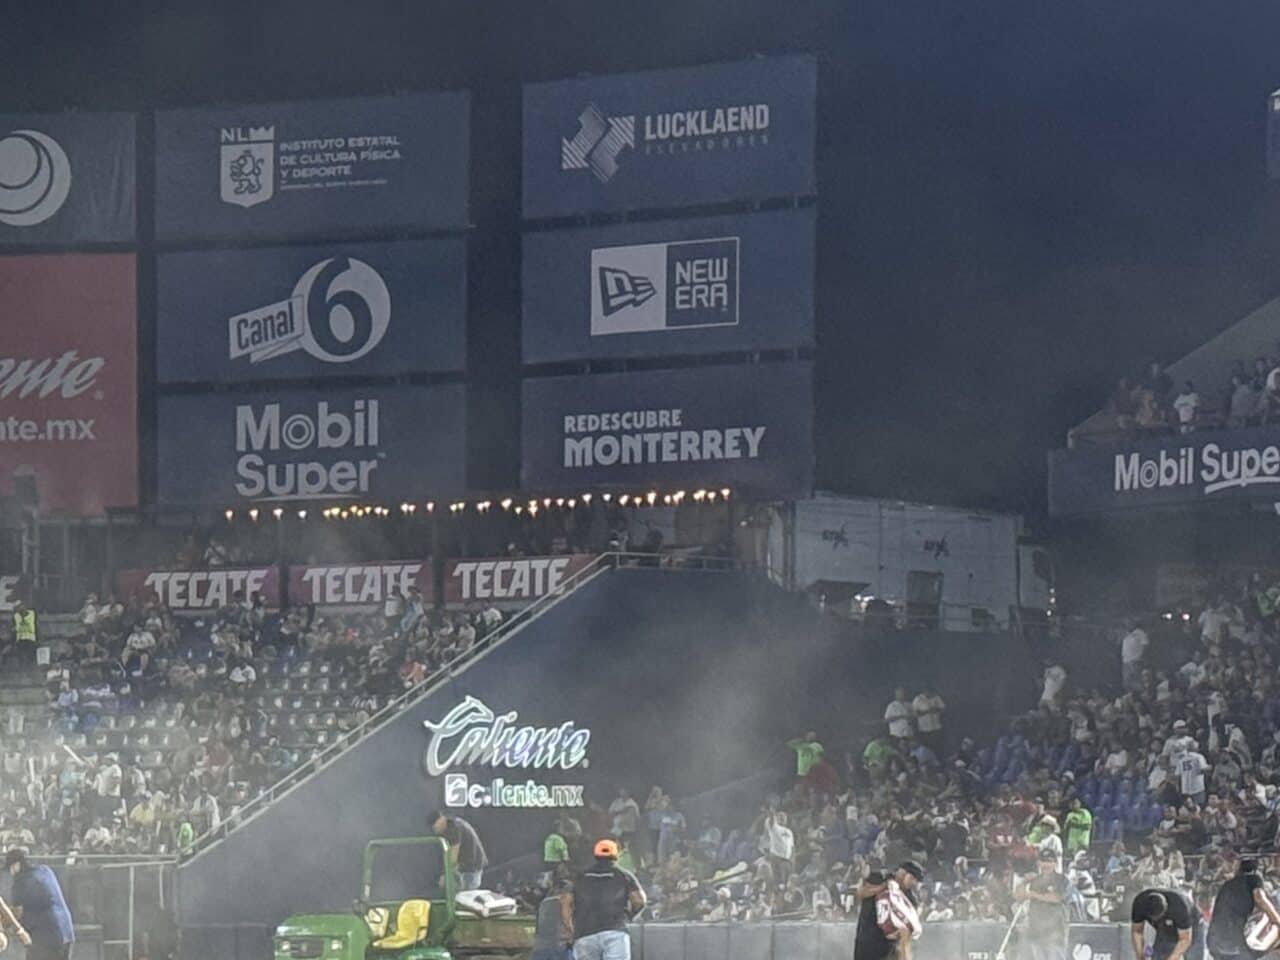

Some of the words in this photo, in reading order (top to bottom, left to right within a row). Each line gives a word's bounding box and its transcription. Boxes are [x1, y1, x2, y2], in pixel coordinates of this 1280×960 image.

[645, 104, 769, 141] LUCKLAEND
[280, 138, 345, 152] INSTITUTO
[348, 135, 400, 148] ESTATAL
[280, 154, 297, 166] DE
[300, 151, 357, 165] CULTURA
[293, 165, 352, 179] DEPORTE
[675, 256, 729, 286] NEW
[674, 282, 729, 311] ERA
[236, 301, 295, 351] Canal
[235, 399, 380, 452] Mobil
[564, 408, 683, 434] REDESCUBRE
[564, 426, 767, 468] MONTERREY
[234, 453, 379, 498] Super
[1114, 447, 1194, 492] Mobil
[144, 570, 268, 608] TECATE
[303, 565, 423, 603] TECATE
[452, 558, 570, 598] TECATE
[424, 695, 592, 776] Caliente
